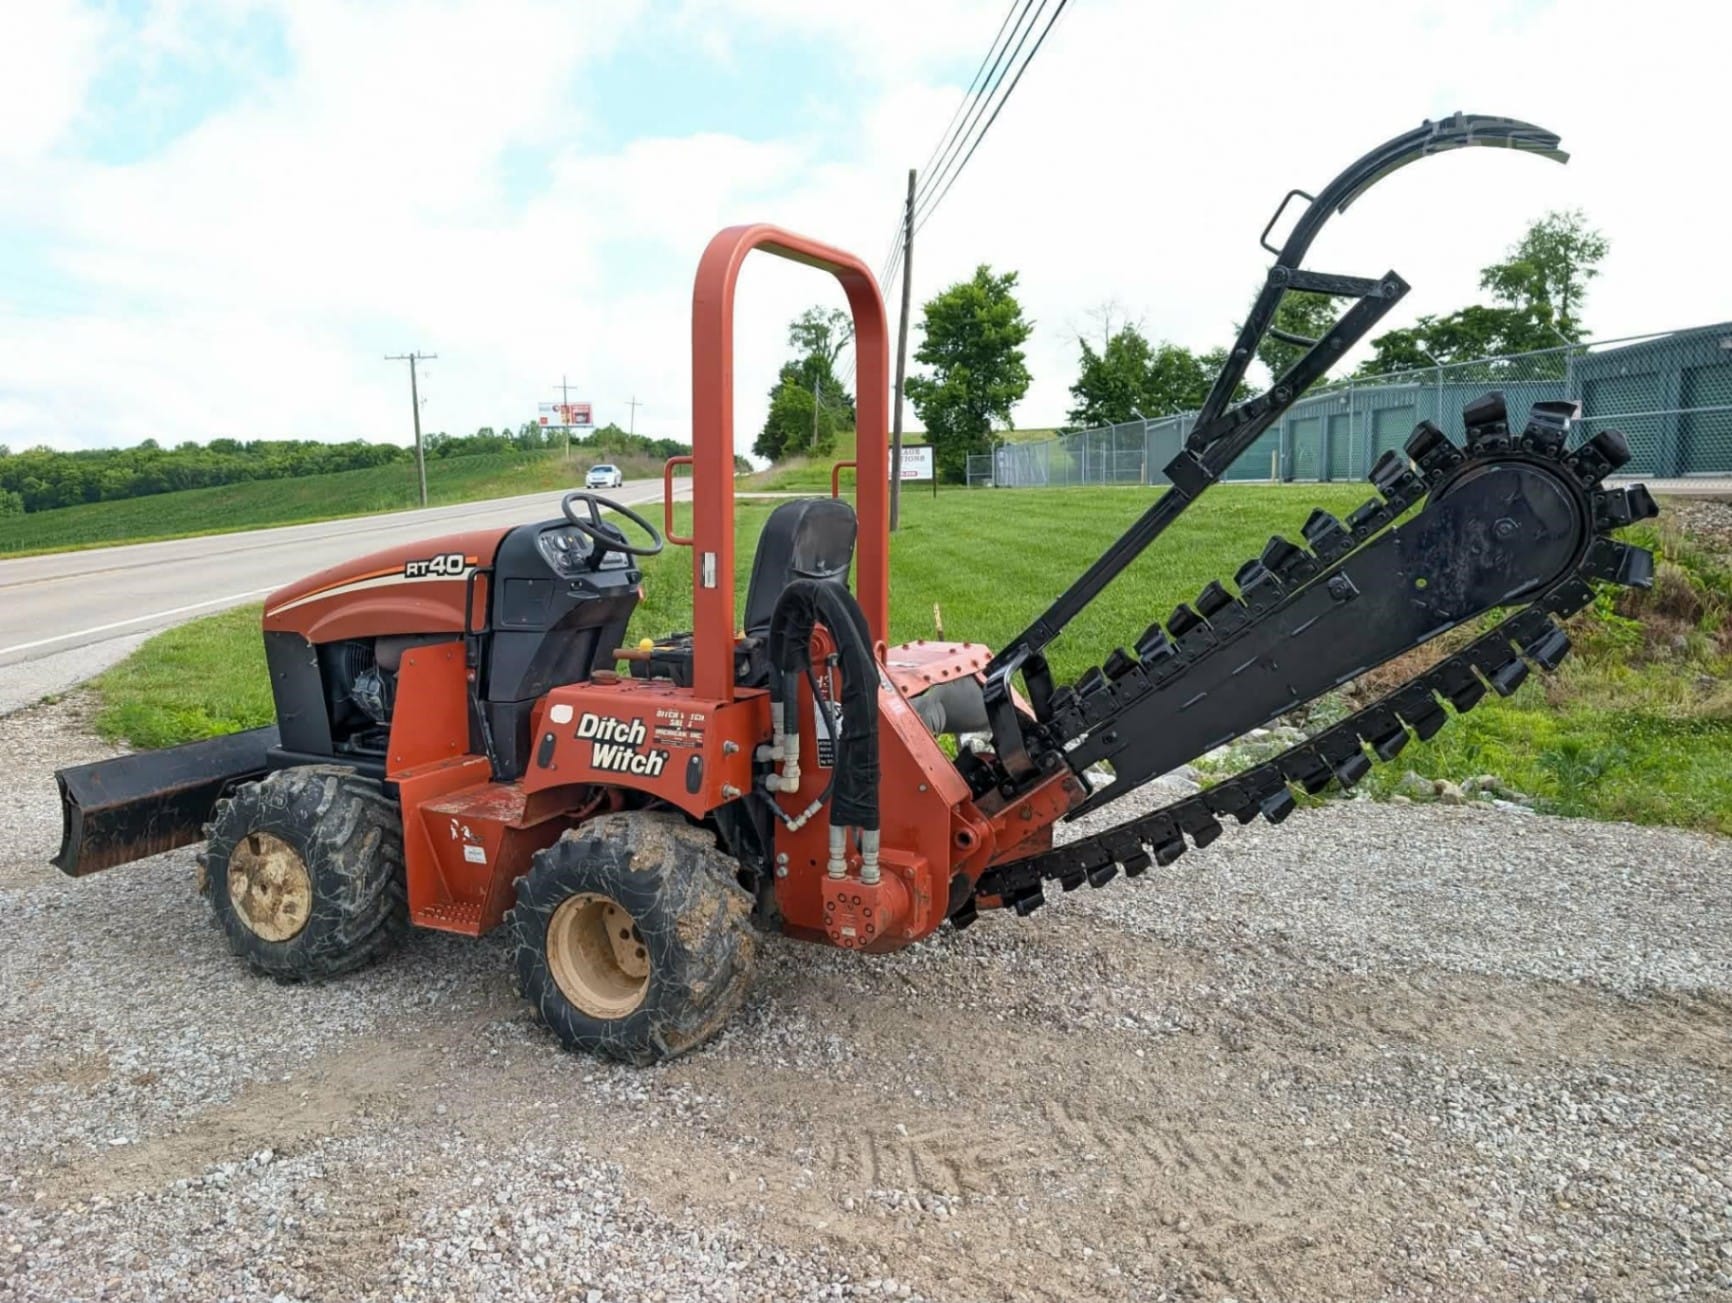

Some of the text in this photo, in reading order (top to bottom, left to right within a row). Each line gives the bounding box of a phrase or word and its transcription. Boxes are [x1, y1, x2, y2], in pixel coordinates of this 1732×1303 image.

[406, 554, 464, 576] RT40
[577, 713, 647, 744] Ditch
[592, 743, 665, 776] Witch
